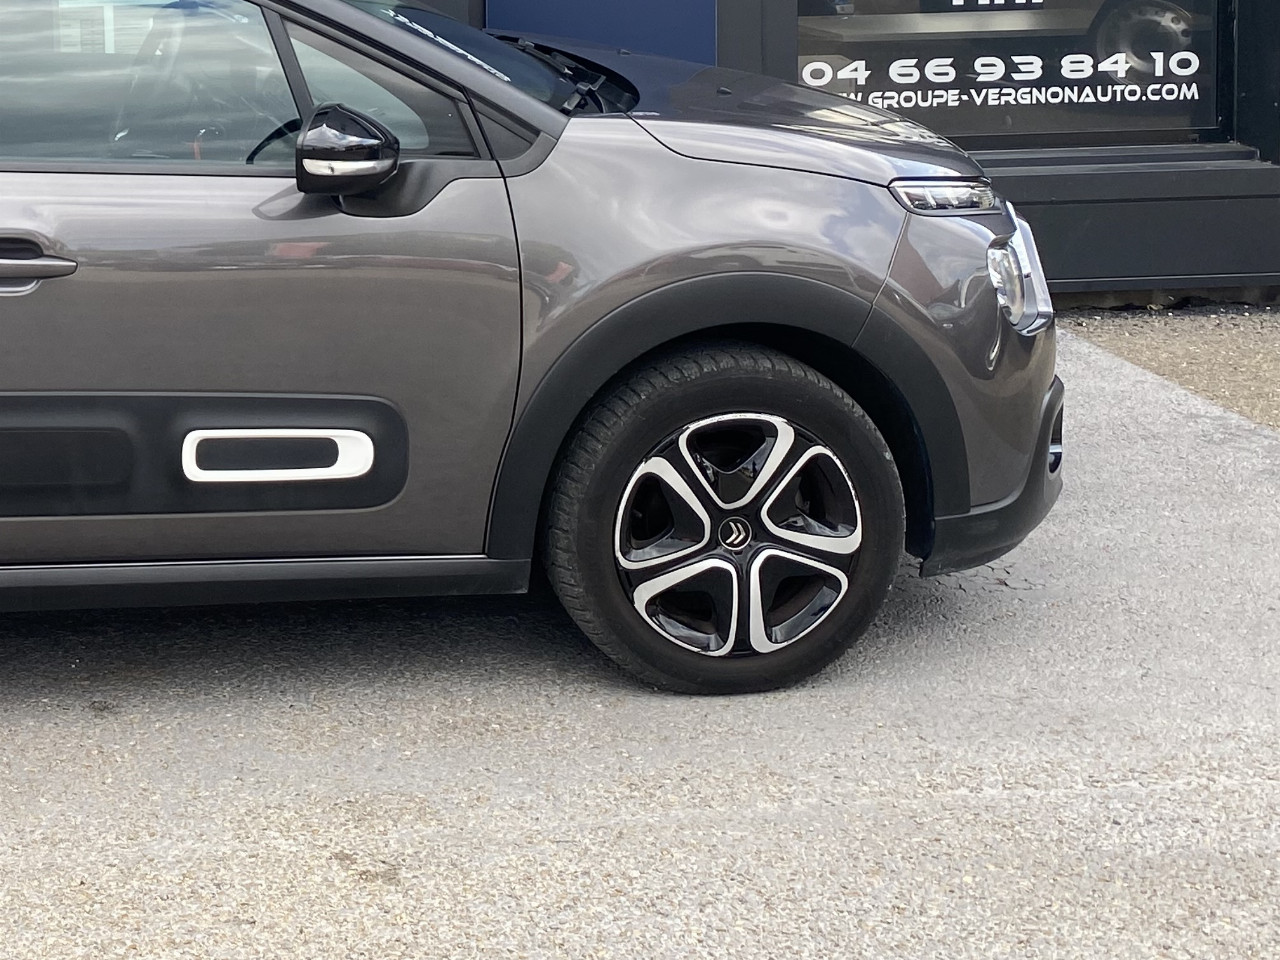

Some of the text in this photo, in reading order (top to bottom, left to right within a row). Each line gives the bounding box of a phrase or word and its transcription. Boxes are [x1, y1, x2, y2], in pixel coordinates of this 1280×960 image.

[801, 51, 1200, 86] 04 66 93 84 10
